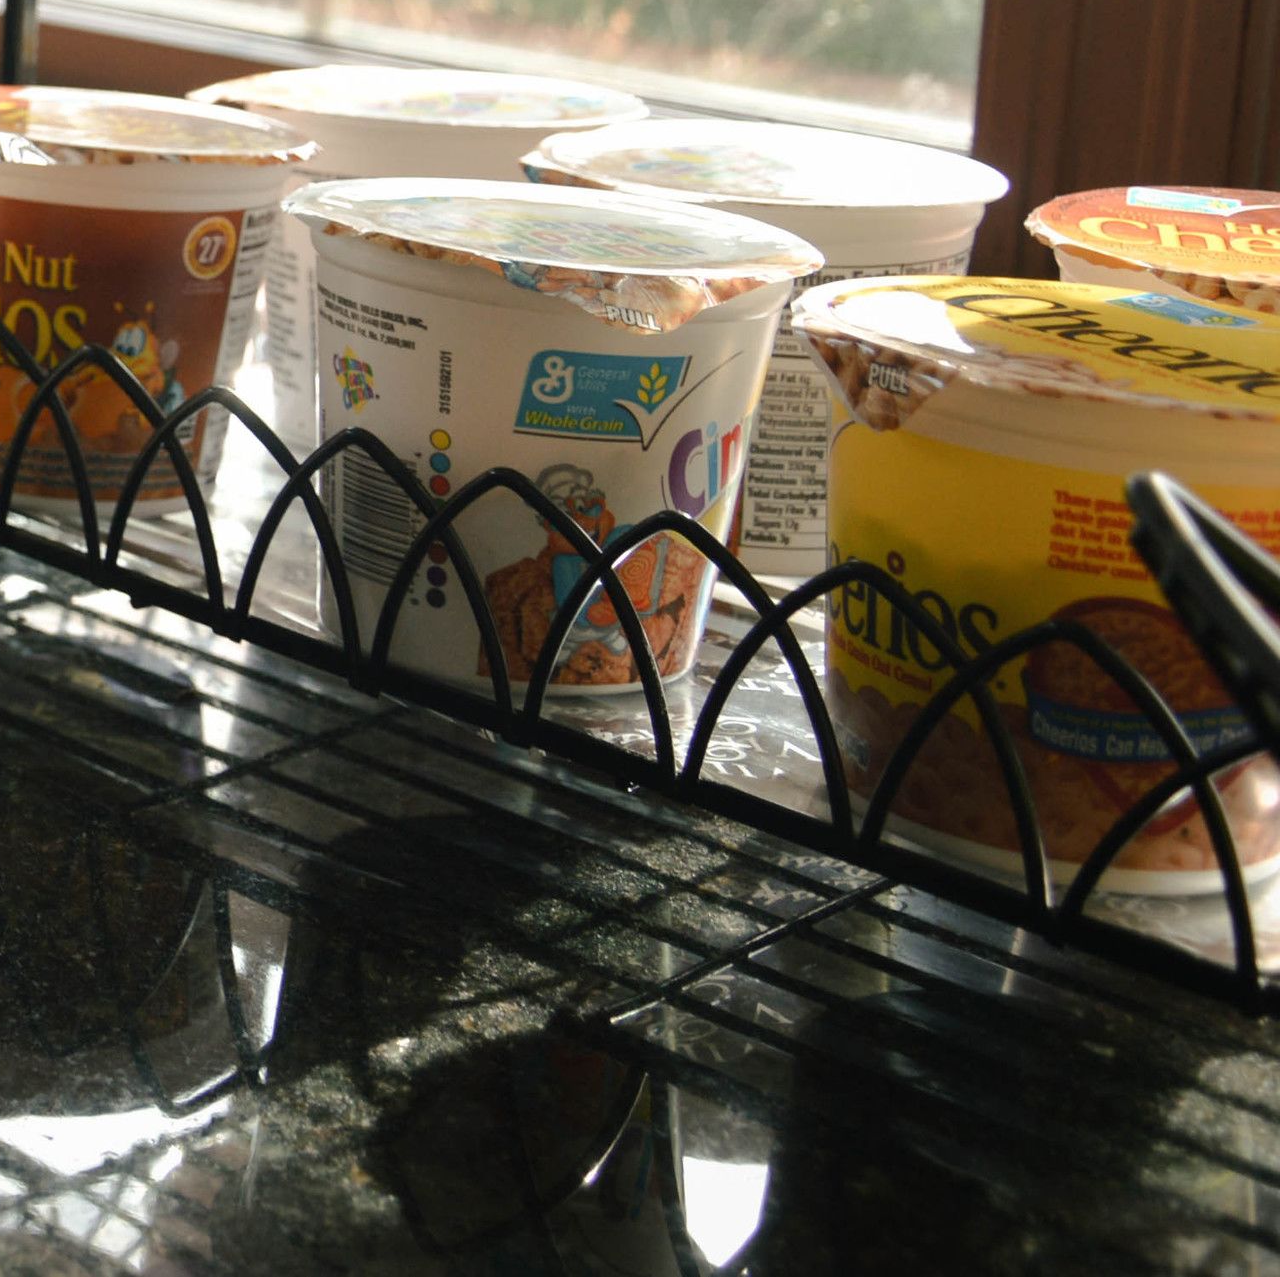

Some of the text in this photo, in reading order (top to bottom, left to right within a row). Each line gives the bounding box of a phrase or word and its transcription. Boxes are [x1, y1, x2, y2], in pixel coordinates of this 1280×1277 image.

[197, 235, 227, 264] 27
[3, 240, 78, 292] Nut
[605, 305, 663, 332] PULL
[867, 362, 910, 397] PULL
[524, 409, 624, 432] Whole Grain
